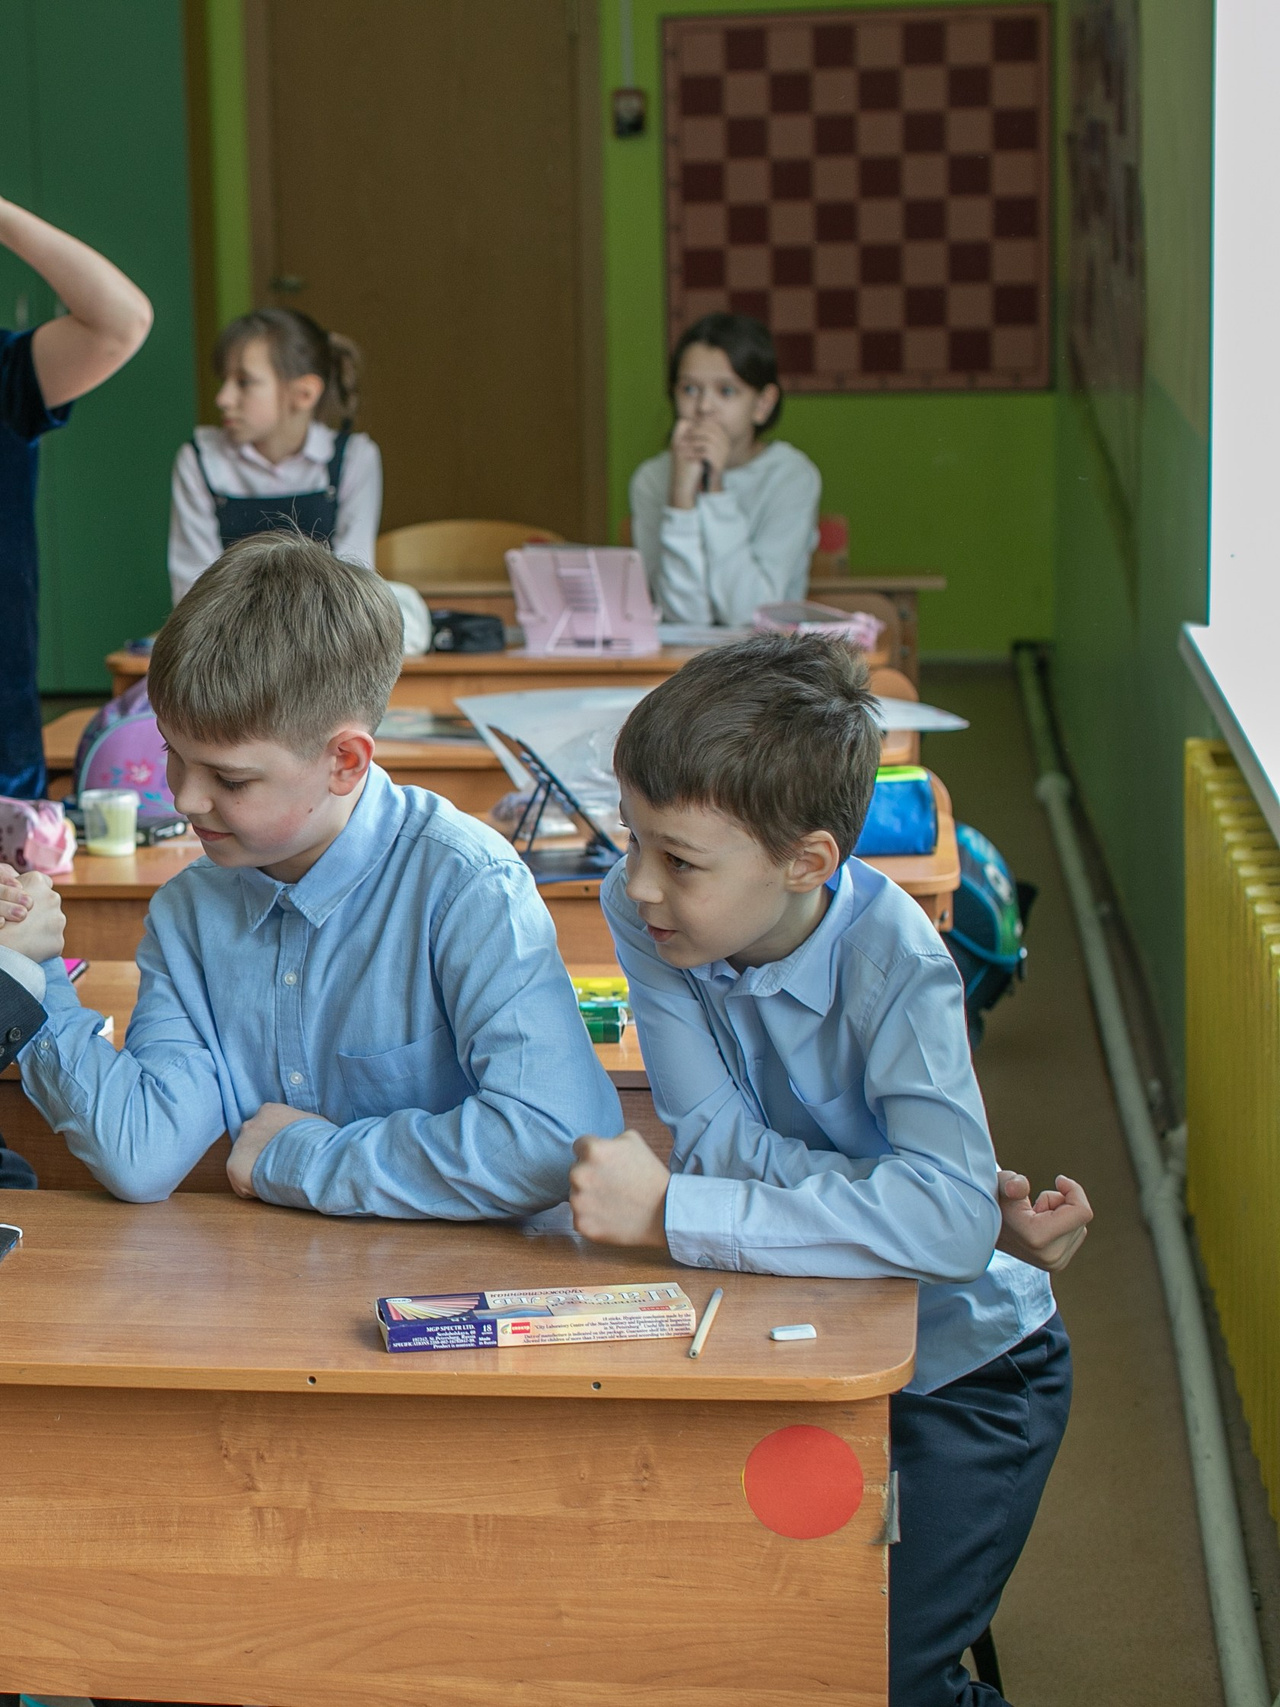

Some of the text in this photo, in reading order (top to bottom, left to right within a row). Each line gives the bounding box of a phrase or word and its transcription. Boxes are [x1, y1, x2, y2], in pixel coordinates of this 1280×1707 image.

[490, 1289, 584, 1298] художественная
[492, 1288, 680, 1305] Пастель
[482, 1324, 492, 1332] 18
